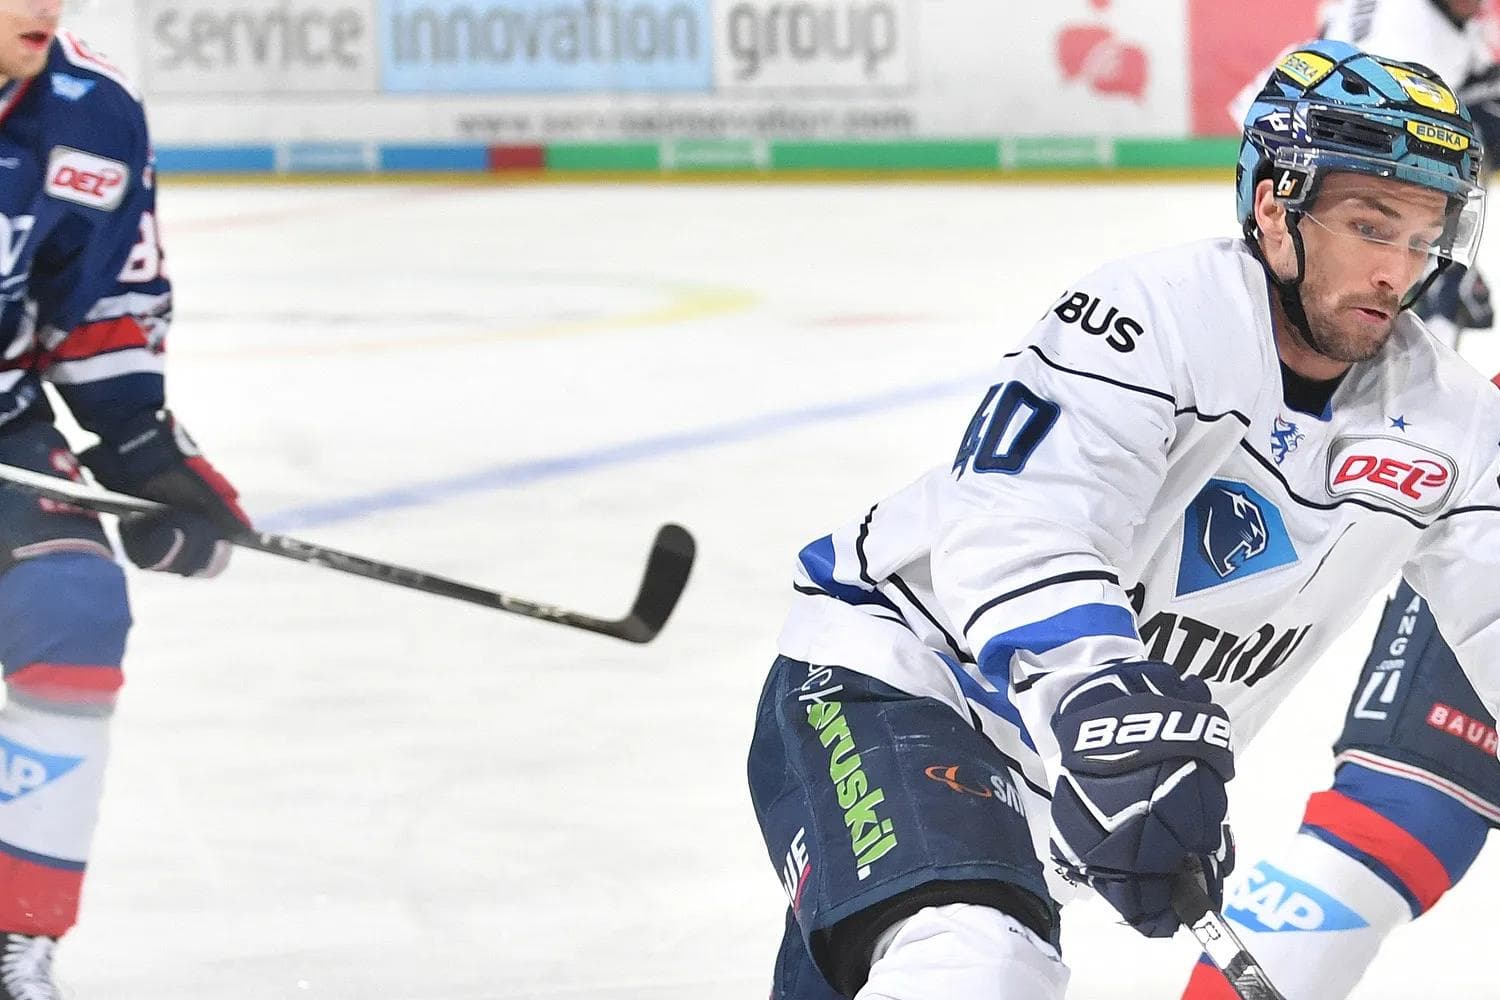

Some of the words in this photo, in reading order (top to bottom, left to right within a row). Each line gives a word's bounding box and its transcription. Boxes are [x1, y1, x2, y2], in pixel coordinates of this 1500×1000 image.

[153, 5, 366, 70] service
[388, 0, 699, 64] innovation
[727, 3, 899, 79] group
[1416, 124, 1462, 147] EDEKA
[1042, 290, 1145, 353] BUS
[1333, 455, 1449, 500] DEL
[1231, 869, 1326, 931] SAP
